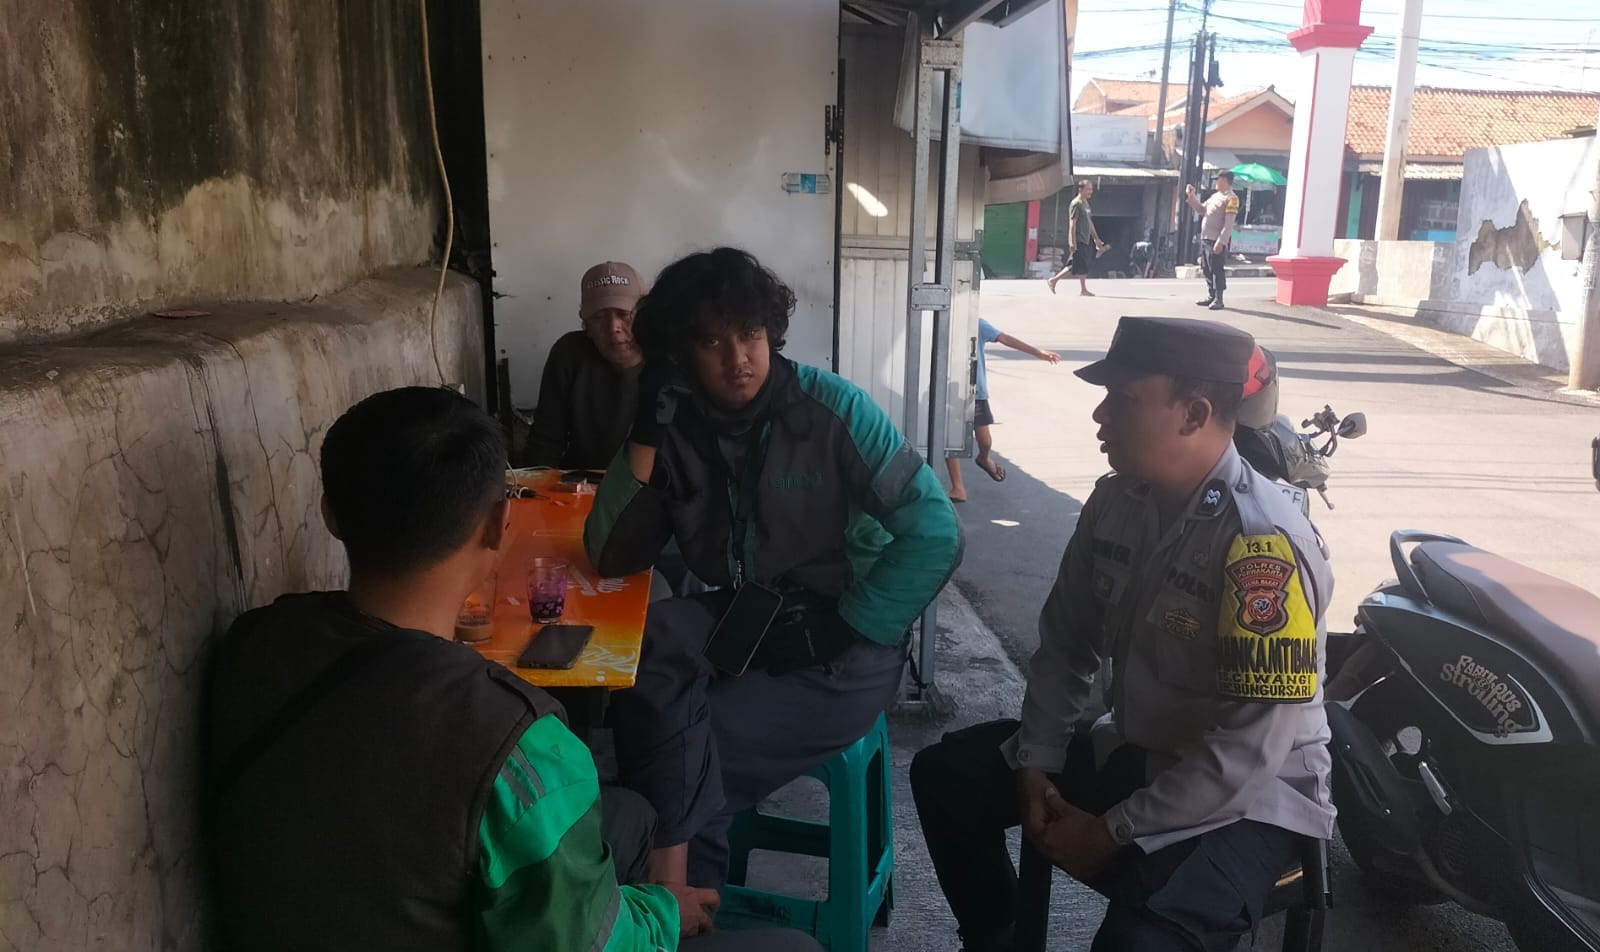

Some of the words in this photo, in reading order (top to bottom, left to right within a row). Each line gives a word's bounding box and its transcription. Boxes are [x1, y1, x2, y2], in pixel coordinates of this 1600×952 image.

[610, 275, 630, 285] ROCK
[1246, 541, 1273, 553] 13.1
[1239, 563, 1281, 574] POLRES
